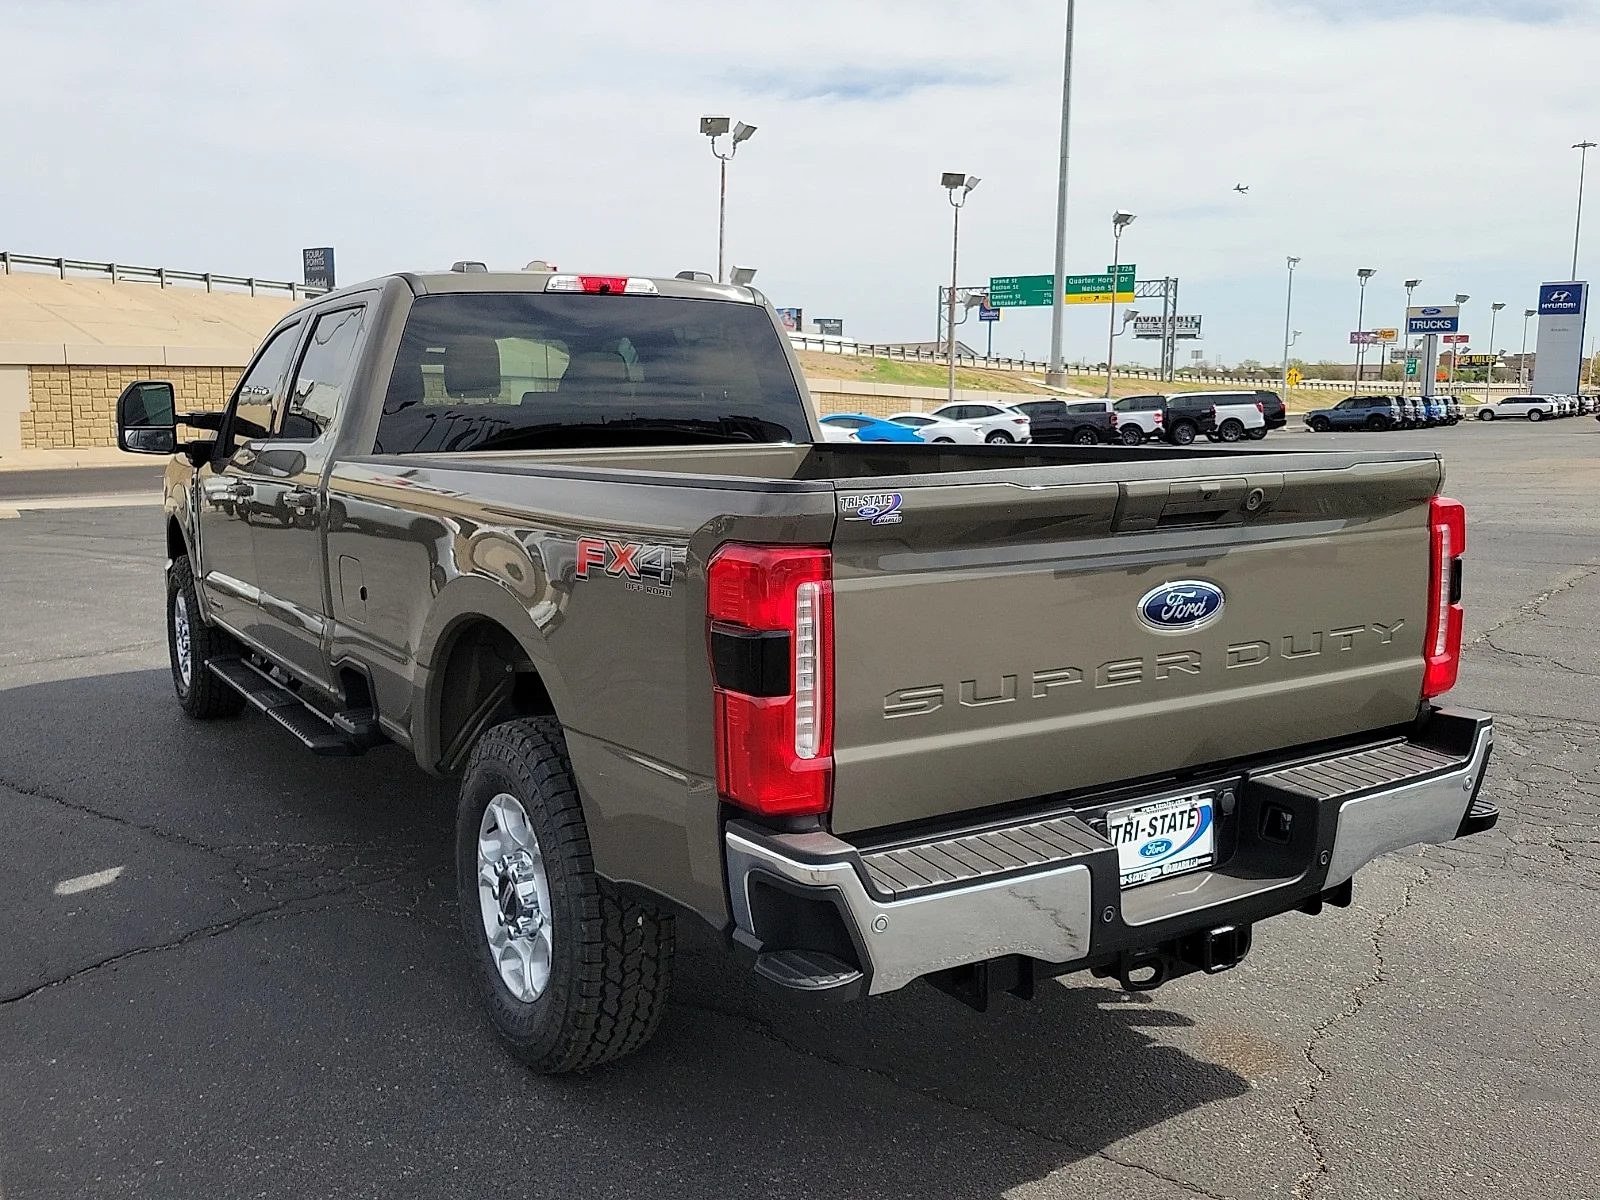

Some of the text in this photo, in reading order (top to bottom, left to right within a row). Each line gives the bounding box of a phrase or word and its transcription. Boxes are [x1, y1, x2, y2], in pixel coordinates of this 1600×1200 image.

[1410, 320, 1452, 330] TRUCKS
[1471, 355, 1496, 363] MILES
[840, 494, 893, 511] TRI-STATE
[575, 535, 675, 588] FX4
[624, 581, 673, 598] OFF ROAD
[1161, 590, 1206, 621] Ford
[883, 618, 1405, 720] SUPER DUTY
[1111, 807, 1197, 848] TRI-STATE
